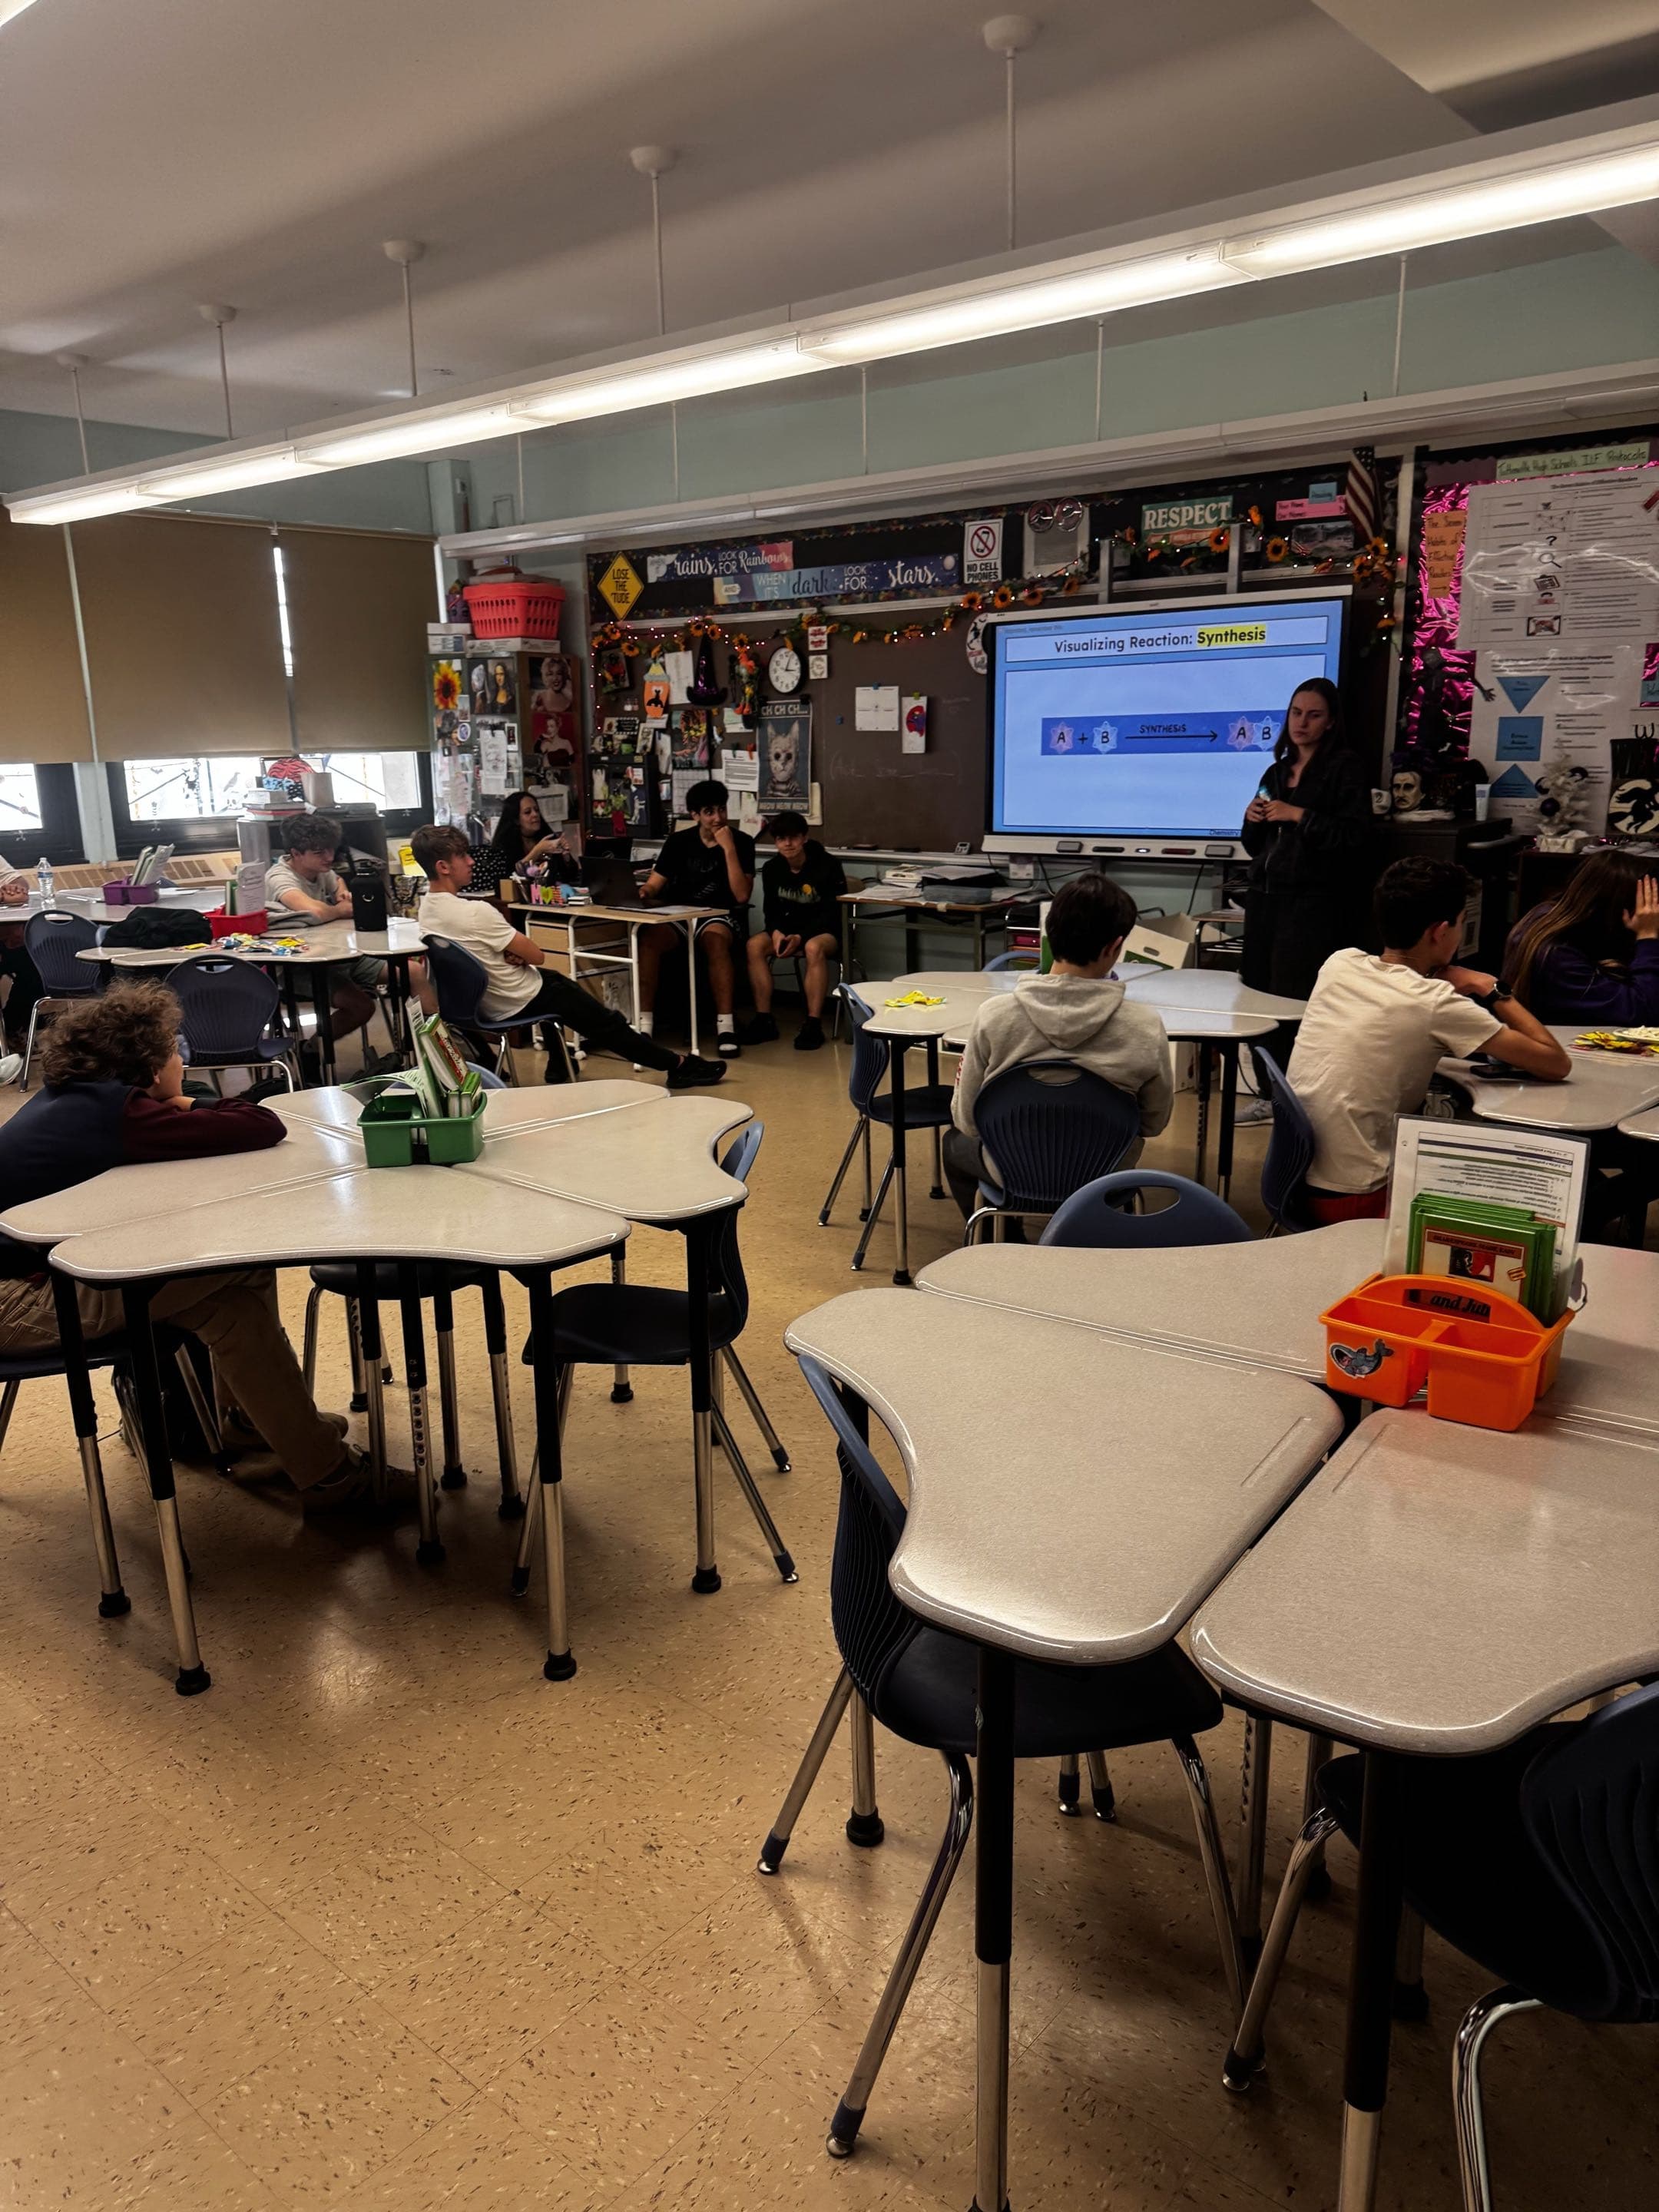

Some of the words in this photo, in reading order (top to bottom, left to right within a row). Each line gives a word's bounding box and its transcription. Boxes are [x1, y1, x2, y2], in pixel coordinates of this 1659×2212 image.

[1144, 502, 1230, 530] RESPECT
[718, 551, 737, 561] LOOK
[718, 561, 738, 574] FOR
[844, 566, 866, 576] LOOK
[967, 563, 978, 573] NO
[980, 562, 998, 571] CELL
[612, 568, 630, 581] LOSE
[758, 574, 786, 585] WHEN
[967, 571, 998, 583] PHONES
[615, 580, 627, 591] THE
[792, 570, 829, 594] dark
[845, 577, 866, 591] FOR
[1055, 636, 1124, 653] Visualizing
[1130, 632, 1193, 649] Reaction:
[1197, 628, 1266, 647] Synthesis
[761, 705, 773, 716] CH
[774, 704, 786, 715] CH
[1140, 724, 1187, 734] SYNTHESIS
[1237, 727, 1247, 740] A
[1262, 727, 1272, 740] B
[1057, 731, 1066, 743] A
[1101, 731, 1110, 743] B
[1430, 1294, 1462, 1310] and
